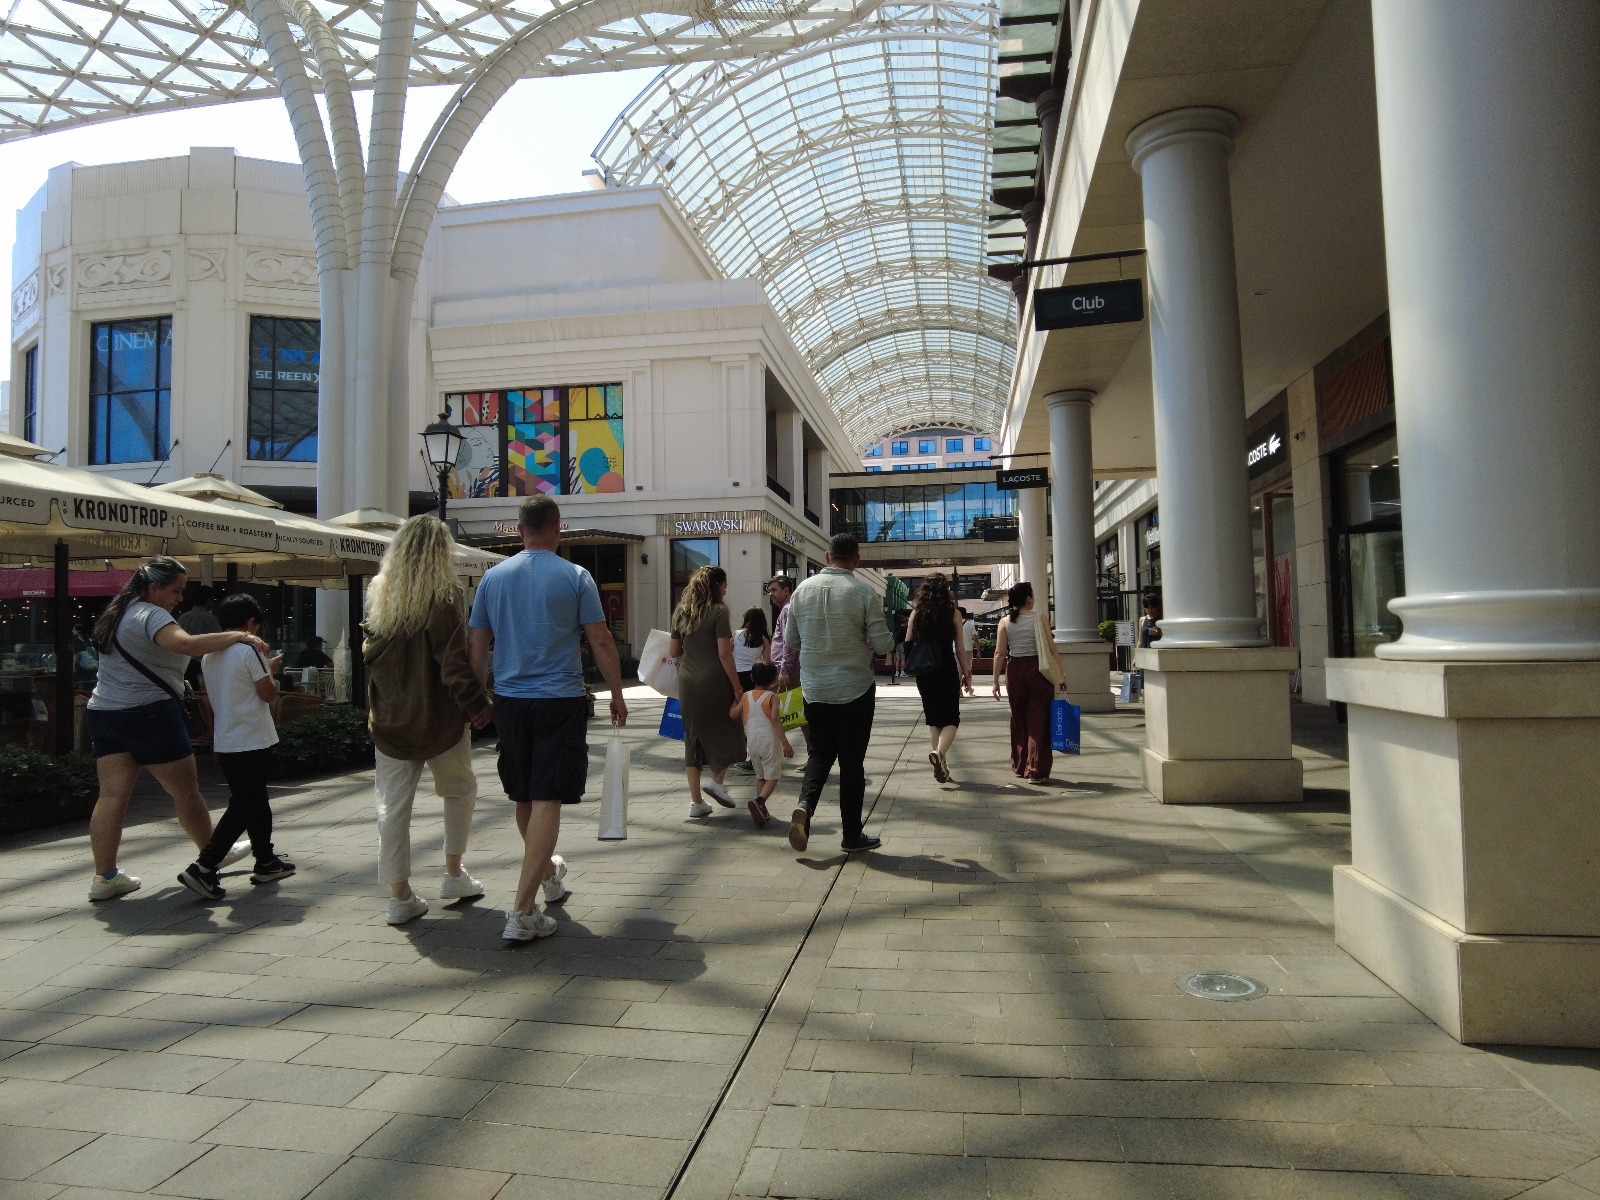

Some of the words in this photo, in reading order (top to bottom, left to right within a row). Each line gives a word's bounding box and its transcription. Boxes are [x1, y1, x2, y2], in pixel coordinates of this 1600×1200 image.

[1072, 296, 1105, 310] Club
[1248, 443, 1268, 466] COSTE
[1003, 475, 1041, 483] LACOSTE
[0, 496, 35, 508] URCED
[74, 498, 168, 528] KRONOTROP
[186, 520, 214, 531] COFFEE
[216, 524, 230, 533] BAR
[239, 528, 273, 539] ROASTERY
[675, 519, 743, 533] SWAROVSKI
[299, 537, 323, 546] SOURCED
[339, 538, 386, 557] KRONOTROP
